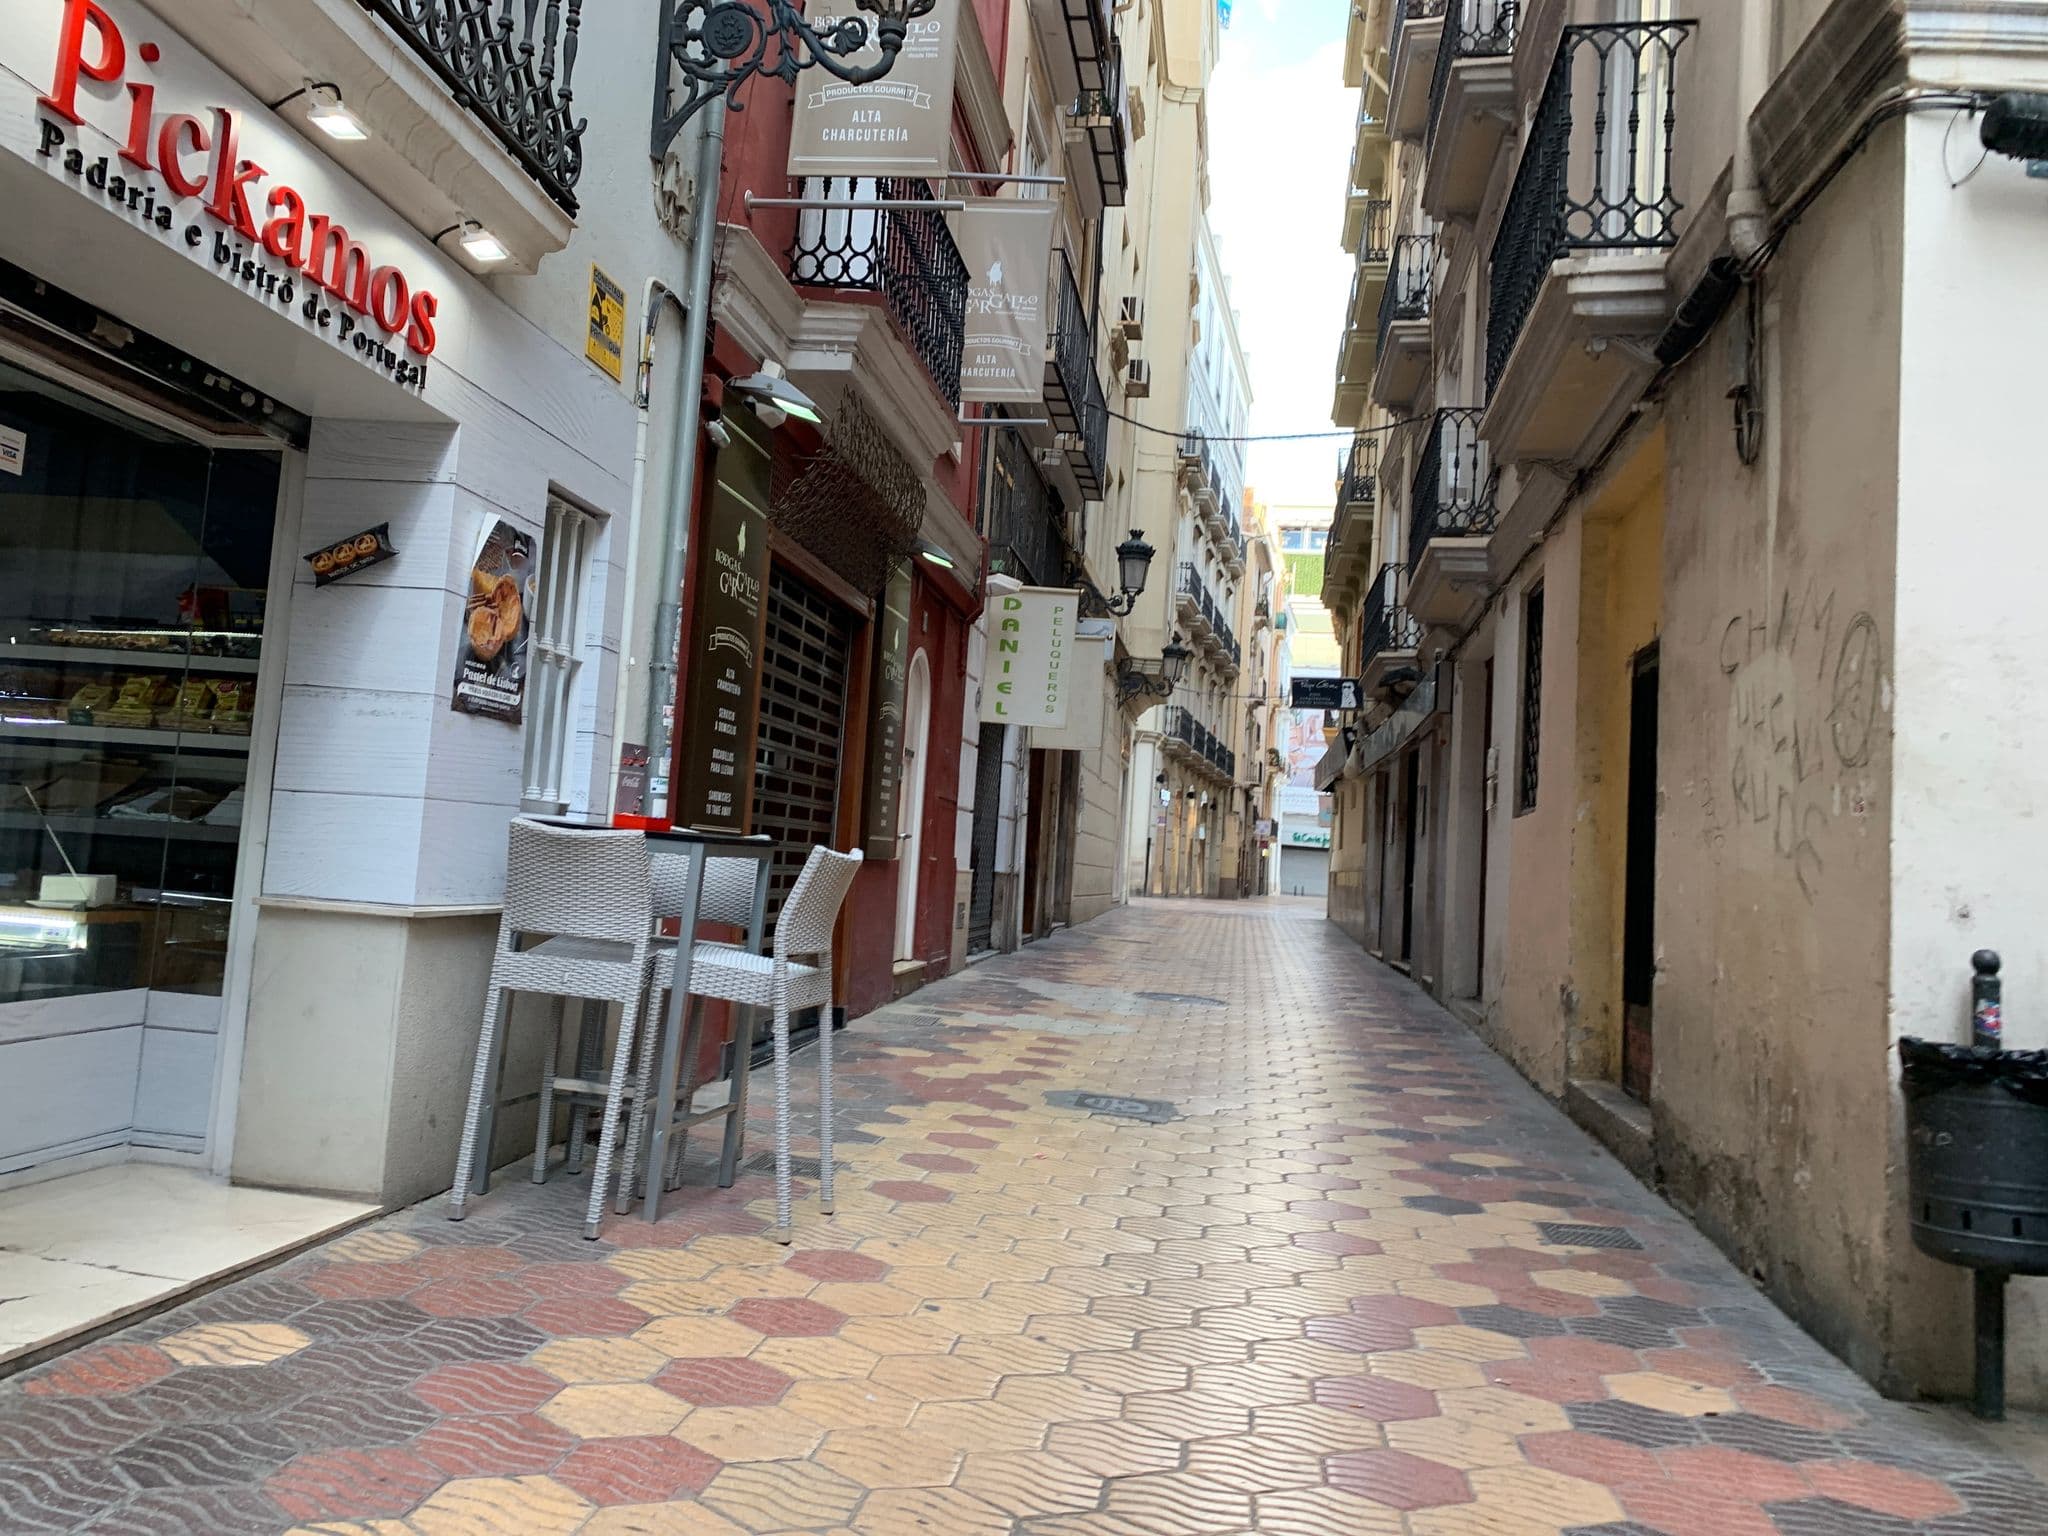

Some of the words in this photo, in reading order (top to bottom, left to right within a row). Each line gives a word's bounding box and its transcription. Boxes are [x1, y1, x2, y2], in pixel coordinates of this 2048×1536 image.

[826, 85, 873, 97] PRODUCTOS
[852, 110, 881, 122] ALTA
[822, 127, 908, 141] CHARCUTERÍA
[37, 0, 438, 355] Pickamos
[38, 118, 173, 230] Padaria
[185, 223, 202, 247] e
[213, 231, 294, 304] bistrô
[302, 293, 330, 328] de
[339, 311, 427, 389] Portugal
[976, 354, 997, 364] ALTA
[961, 367, 1016, 378] HARCUTERÍA
[995, 597, 1022, 715] DANIEL
[1045, 606, 1064, 714] PELUQUEROS
[463, 667, 487, 683] Pastel
[487, 673, 497, 686] de
[497, 676, 519, 692] Lisboa
